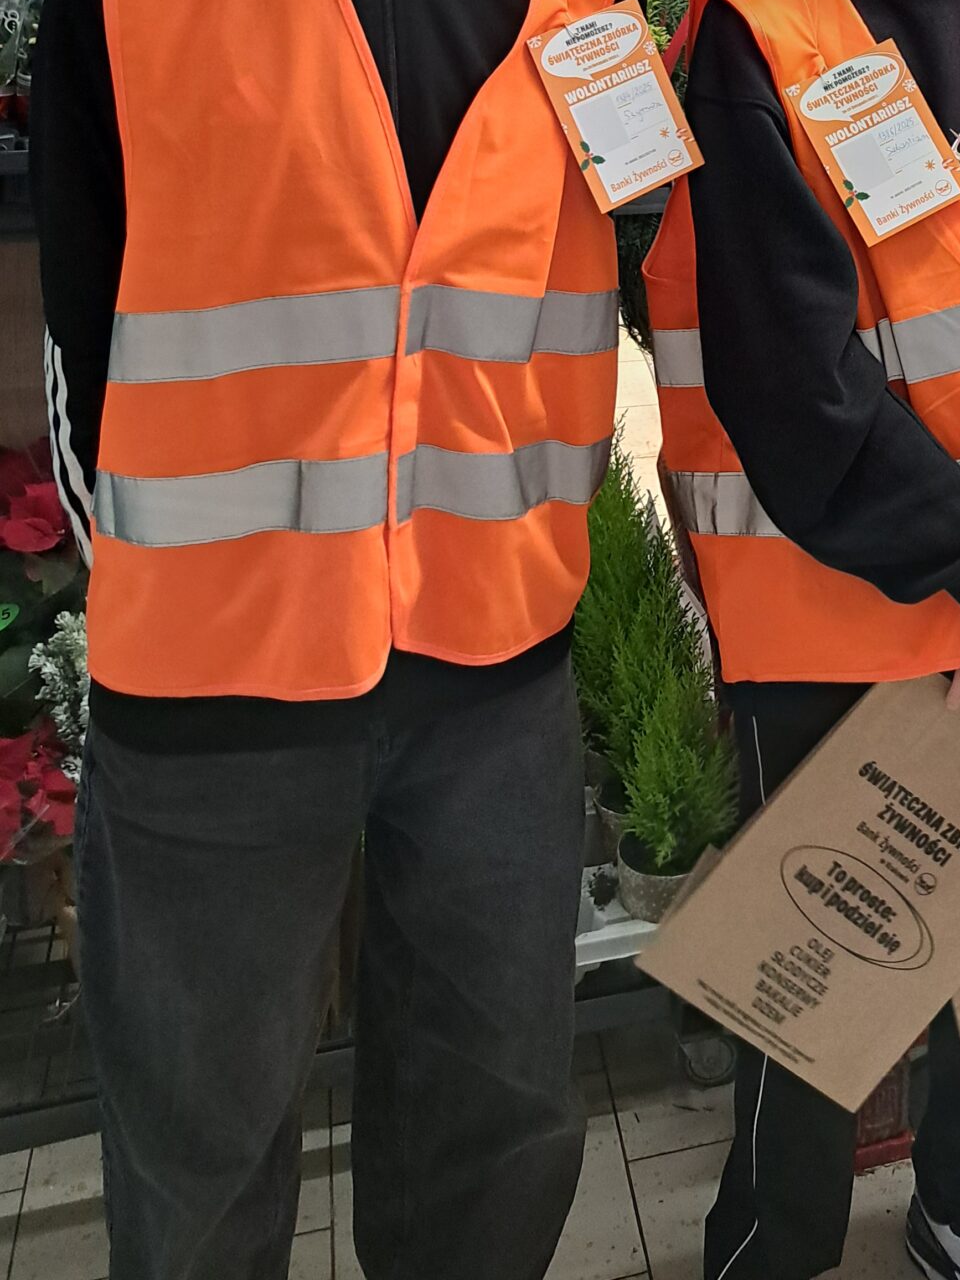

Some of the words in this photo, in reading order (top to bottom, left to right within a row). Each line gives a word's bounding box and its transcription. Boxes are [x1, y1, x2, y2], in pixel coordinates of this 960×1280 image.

[547, 37, 603, 67] ŚWIĄTECZNA
[599, 22, 639, 47] ZBIÓRKA
[580, 21, 598, 33] NAMI
[574, 41, 621, 67] ŻYWNOŚCI
[837, 65, 854, 78] NAMI
[564, 59, 653, 104] WOLONTARIUSZ
[805, 81, 861, 112] ŚWIĄTECZNA
[860, 63, 897, 88] ZBIÓRKA
[833, 82, 879, 110] ŻYWNOŚCI
[824, 96, 913, 147] WOLONTARIUSZ
[610, 174, 634, 193] Banki
[634, 159, 668, 184] Żywności
[875, 206, 900, 227] Banki
[898, 189, 936, 216] Żywności
[1, 608, 11, 620] 5
[858, 760, 946, 830] ŚWIĄTECZNA
[856, 821, 880, 842] Bank
[878, 835, 921, 875] Żywności
[877, 803, 953, 867] ŻYWNOŚCI
[794, 864, 823, 899] kup
[820, 882, 830, 901] i
[825, 888, 880, 941] podziel
[877, 926, 902, 955] się
[826, 859, 845, 885] To
[843, 873, 897, 924] proste:
[789, 945, 832, 977] CUKIER
[807, 937, 836, 961] OLEJ
[756, 960, 821, 1010] KONSERWY
[771, 950, 829, 996] SŁODYCZE
[755, 979, 804, 1018] BAKALIE
